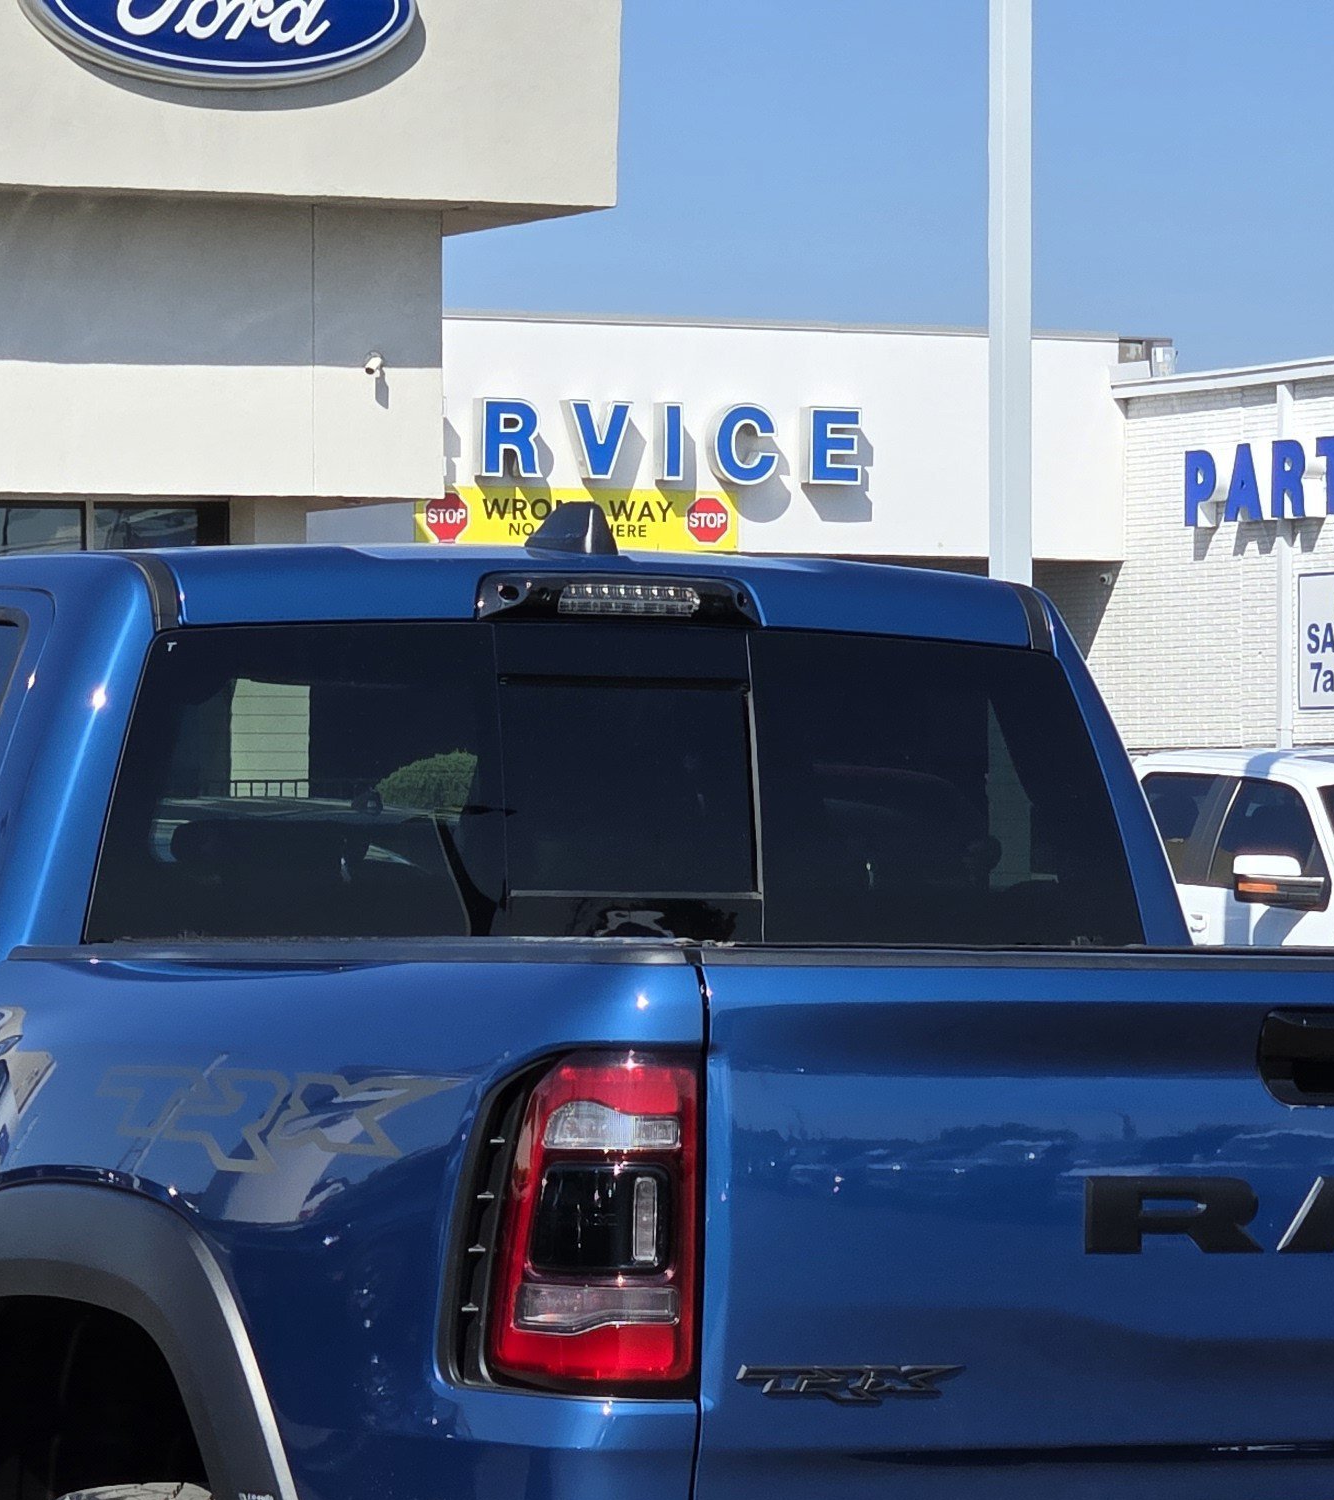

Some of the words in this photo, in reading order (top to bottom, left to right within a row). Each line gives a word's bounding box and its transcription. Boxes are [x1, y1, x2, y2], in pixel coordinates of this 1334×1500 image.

[477, 397, 863, 486] RVICE
[427, 508, 466, 525] STOP
[482, 498, 563, 521] WRO
[610, 500, 673, 523] WAY
[689, 512, 728, 530] STOP
[611, 524, 647, 538] ERE
[93, 1065, 473, 1175] TRX
[736, 1364, 966, 1406] TRX
